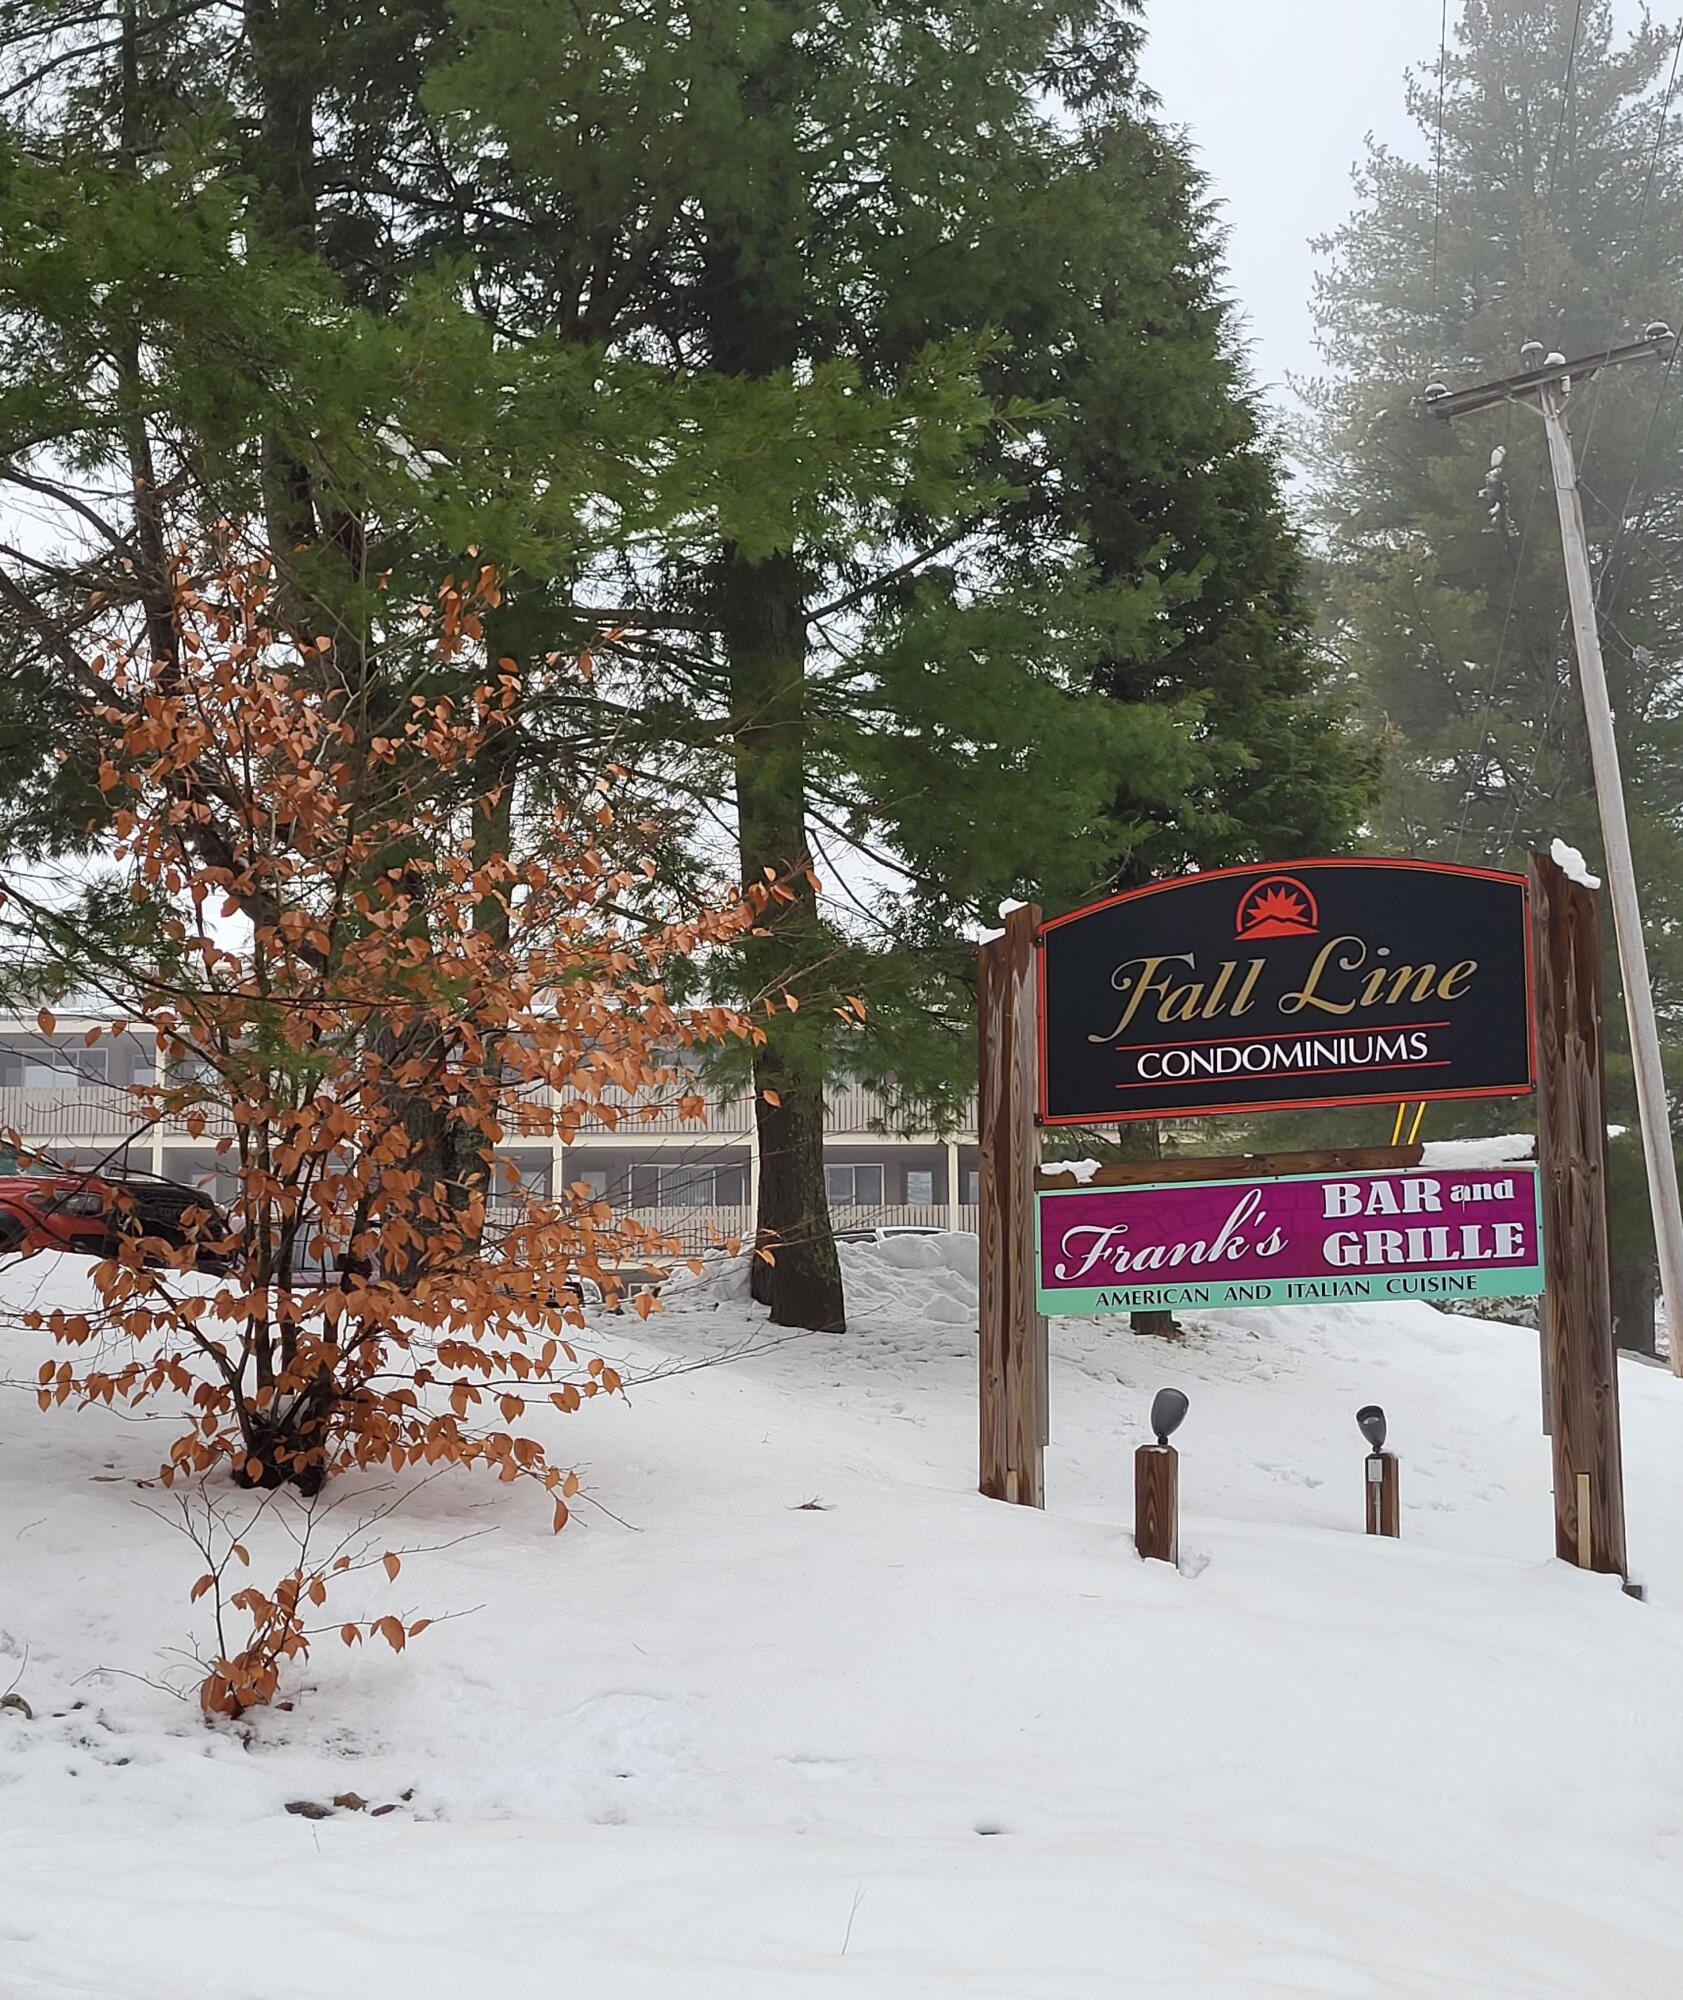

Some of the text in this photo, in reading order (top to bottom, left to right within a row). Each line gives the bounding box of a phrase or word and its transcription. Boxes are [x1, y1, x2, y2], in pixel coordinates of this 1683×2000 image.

[1087, 935, 1478, 1043] Fall Line
[1136, 1032, 1428, 1079] CONDOMINIUMS
[1321, 1178, 1515, 1218] BAR and
[1054, 1188, 1288, 1280] Frank's
[1322, 1222, 1525, 1267] GRILLE
[1096, 1275, 1478, 1307] AMERICAN AND ITALIAN CUISINE
